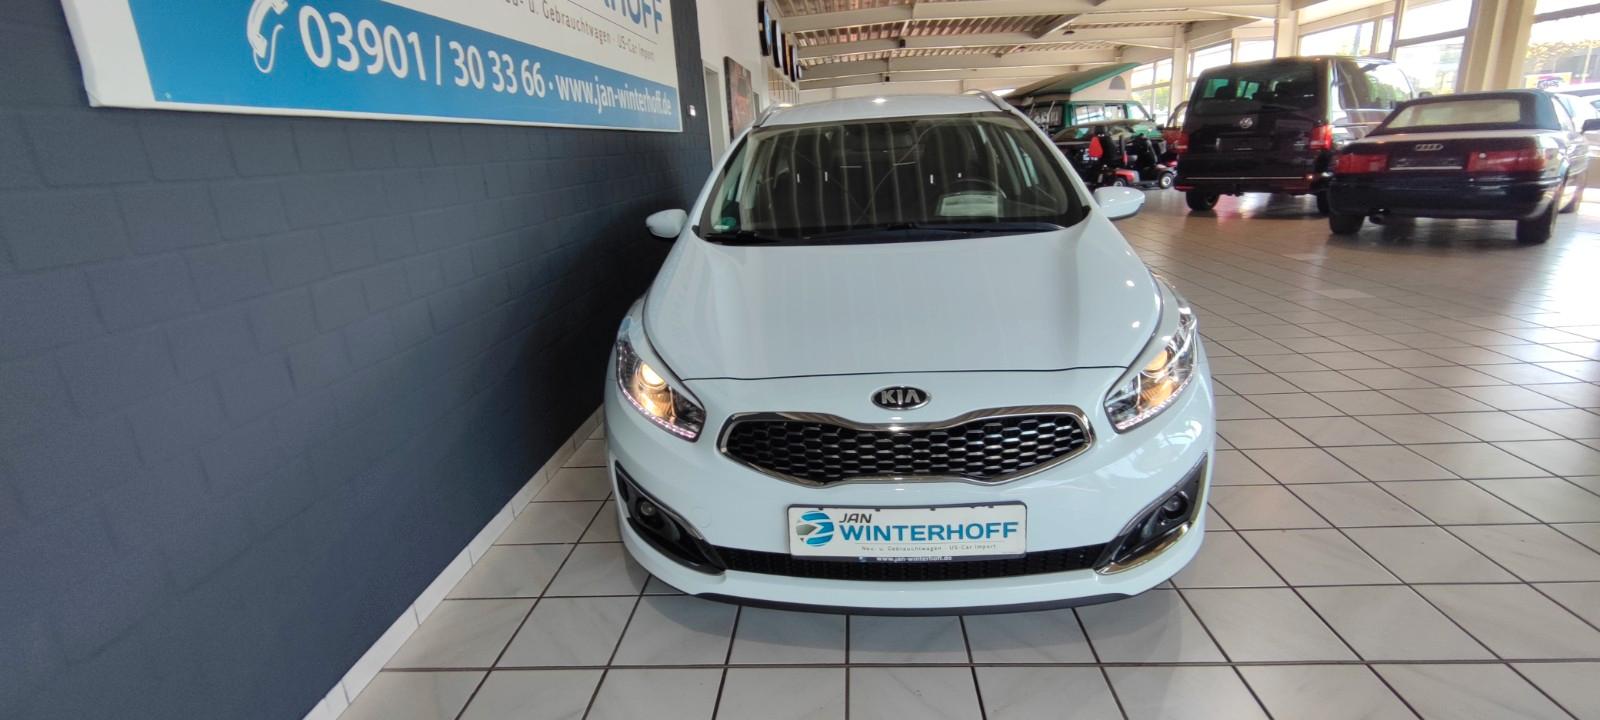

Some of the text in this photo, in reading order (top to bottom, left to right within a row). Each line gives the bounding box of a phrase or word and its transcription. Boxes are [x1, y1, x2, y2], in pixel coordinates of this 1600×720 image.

[542, 0, 611, 46] Gebrauchtwagen
[298, 5, 427, 81] 03901
[449, 41, 486, 90] 30
[488, 50, 518, 94] 33
[521, 59, 546, 98] 66
[555, 74, 672, 116] www.jan-winterhoff.de
[881, 389, 921, 405] KIA
[839, 513, 872, 524] JAN
[839, 521, 1019, 541] WINTERHOFF
